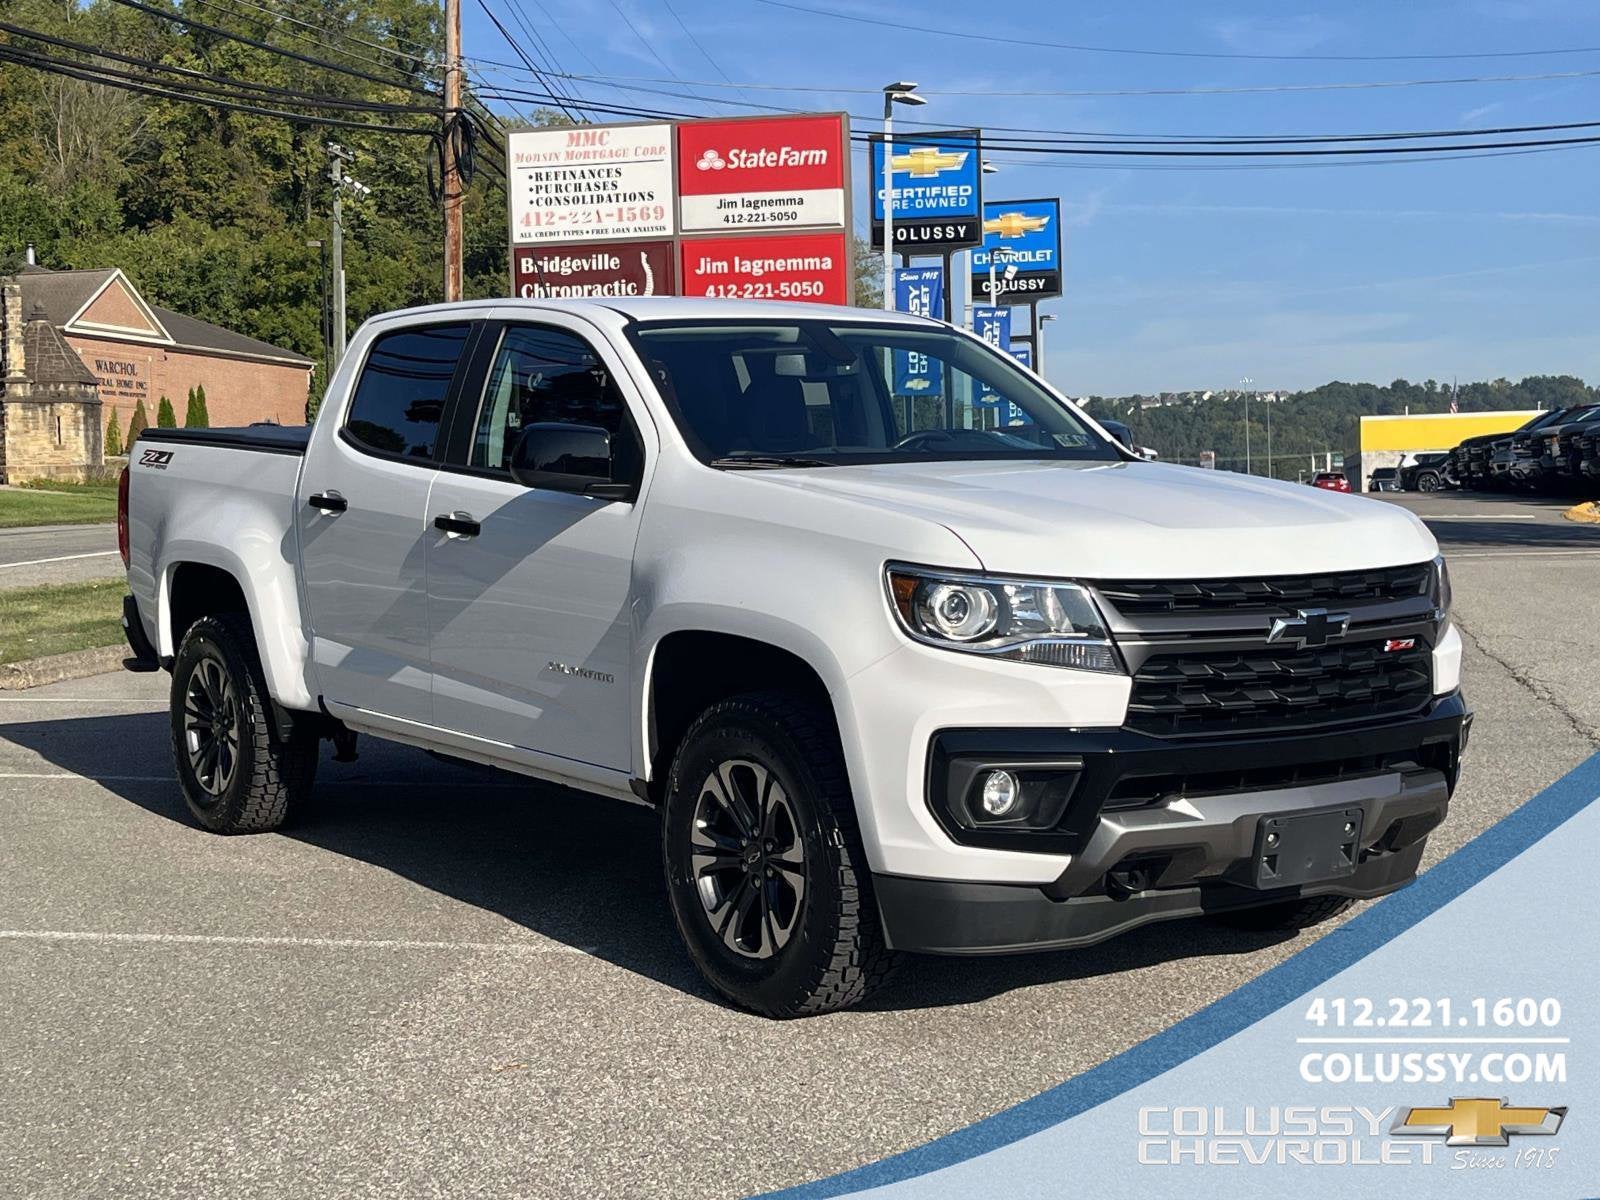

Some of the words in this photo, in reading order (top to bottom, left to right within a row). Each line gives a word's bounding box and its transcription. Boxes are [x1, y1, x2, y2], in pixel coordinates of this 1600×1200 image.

[566, 130, 610, 147] MMC
[564, 147, 629, 161] MORTGAGE
[634, 145, 667, 157] CORP.
[534, 167, 622, 182] REFINANCES
[535, 180, 618, 194] PURCHASES
[536, 191, 654, 207] CONSOLIDATIONS
[716, 199, 738, 209] Jim
[741, 196, 804, 210] Iagnemma
[883, 197, 968, 210] RE-OWNED
[520, 205, 665, 228] 412-221-1569
[723, 211, 798, 224] 412-221-5050
[520, 253, 620, 276] Bridgeville
[973, 249, 1053, 265] CHEVROLET
[694, 257, 728, 275] Jim
[734, 255, 832, 276] Iagnemma
[520, 279, 638, 297] Chiropractic
[705, 280, 824, 299] 412-221-5050
[95, 359, 138, 377] WARCHOL
